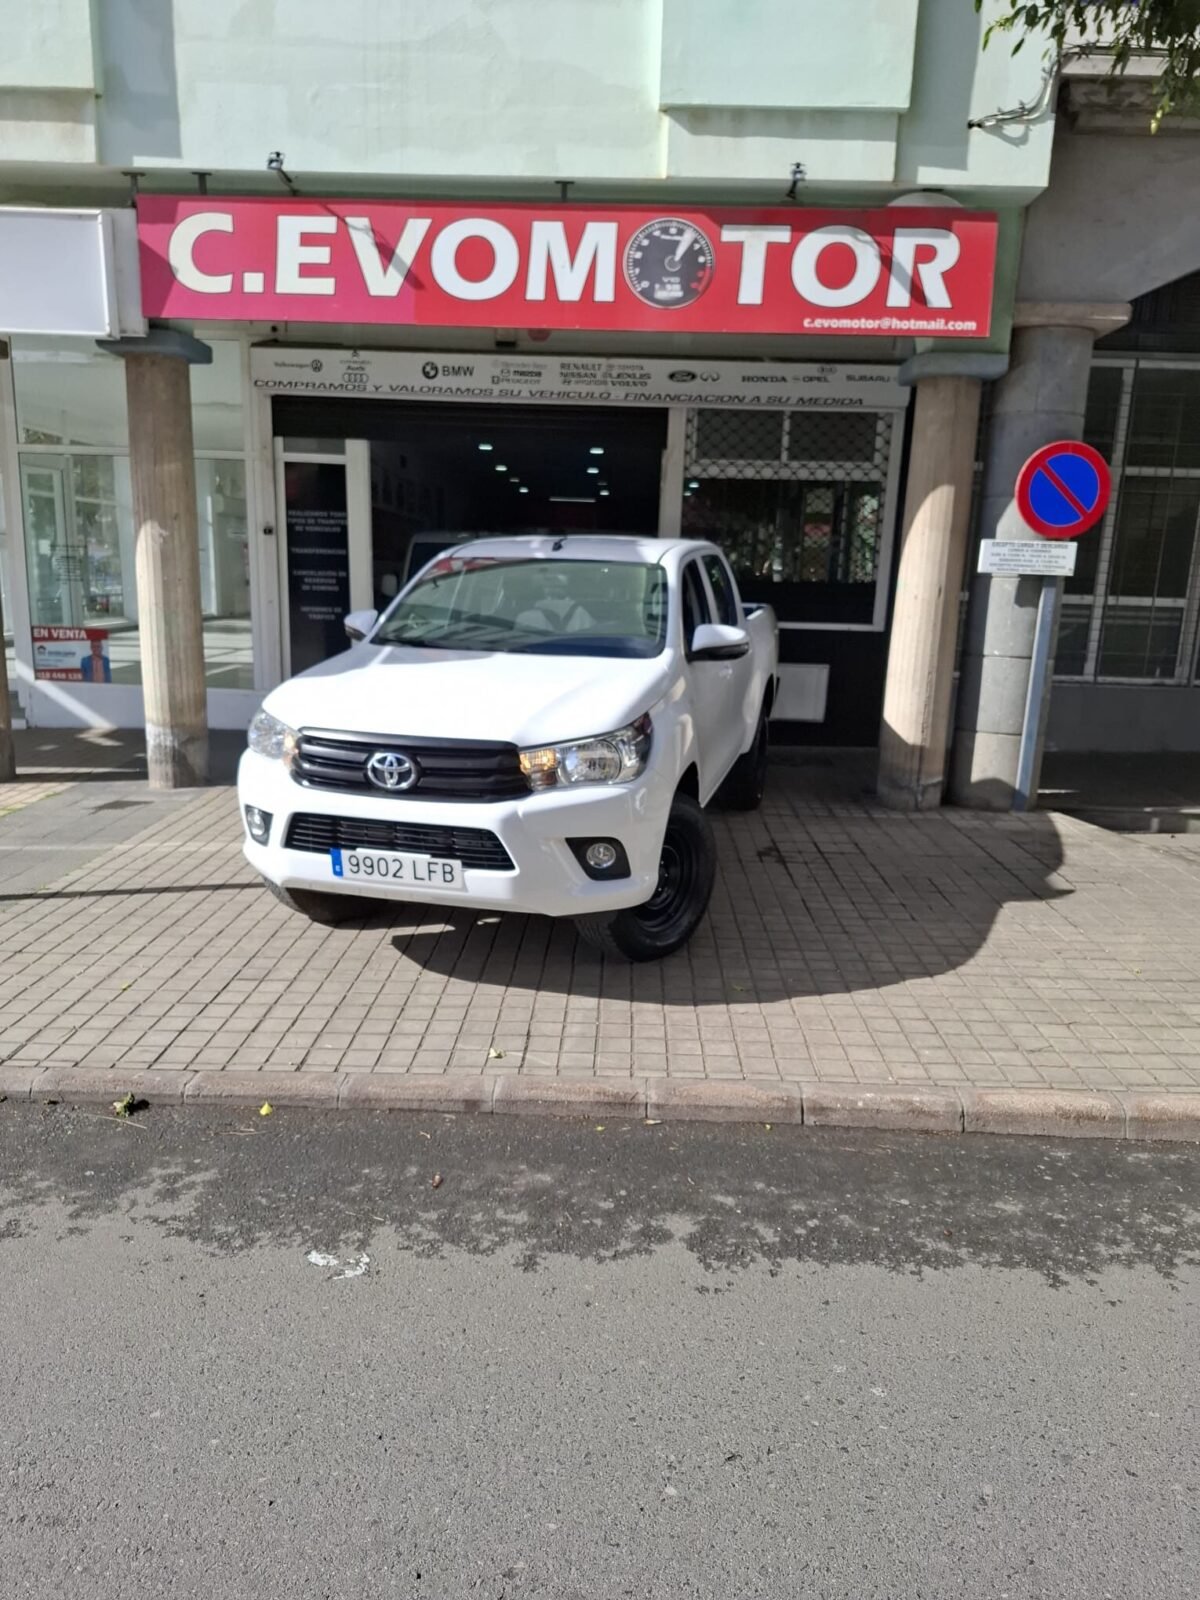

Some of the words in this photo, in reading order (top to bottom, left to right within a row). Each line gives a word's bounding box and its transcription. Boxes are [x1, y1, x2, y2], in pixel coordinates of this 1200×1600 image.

[803, 317, 977, 331] c.evomotor@hotmail.com
[442, 366, 475, 377] BMW
[560, 363, 602, 371] RENAULT
[560, 371, 597, 379] NISSAN
[608, 372, 652, 380] LEXUS
[741, 375, 788, 383] HONDA
[845, 374, 891, 383] SUBARU
[253, 379, 367, 392] COMPRAMOS
[388, 384, 494, 397] VALORAMOS
[498, 389, 523, 397] SU
[529, 389, 611, 401] VEHICULO
[623, 391, 746, 404] FINANCIACION
[750, 395, 761, 403] A
[766, 395, 791, 404] SU
[795, 396, 863, 406] MEDIDA
[33, 628, 48, 638] EN
[51, 629, 87, 639] VENTA
[348, 855, 404, 879] 9902
[413, 860, 455, 883] LFB
